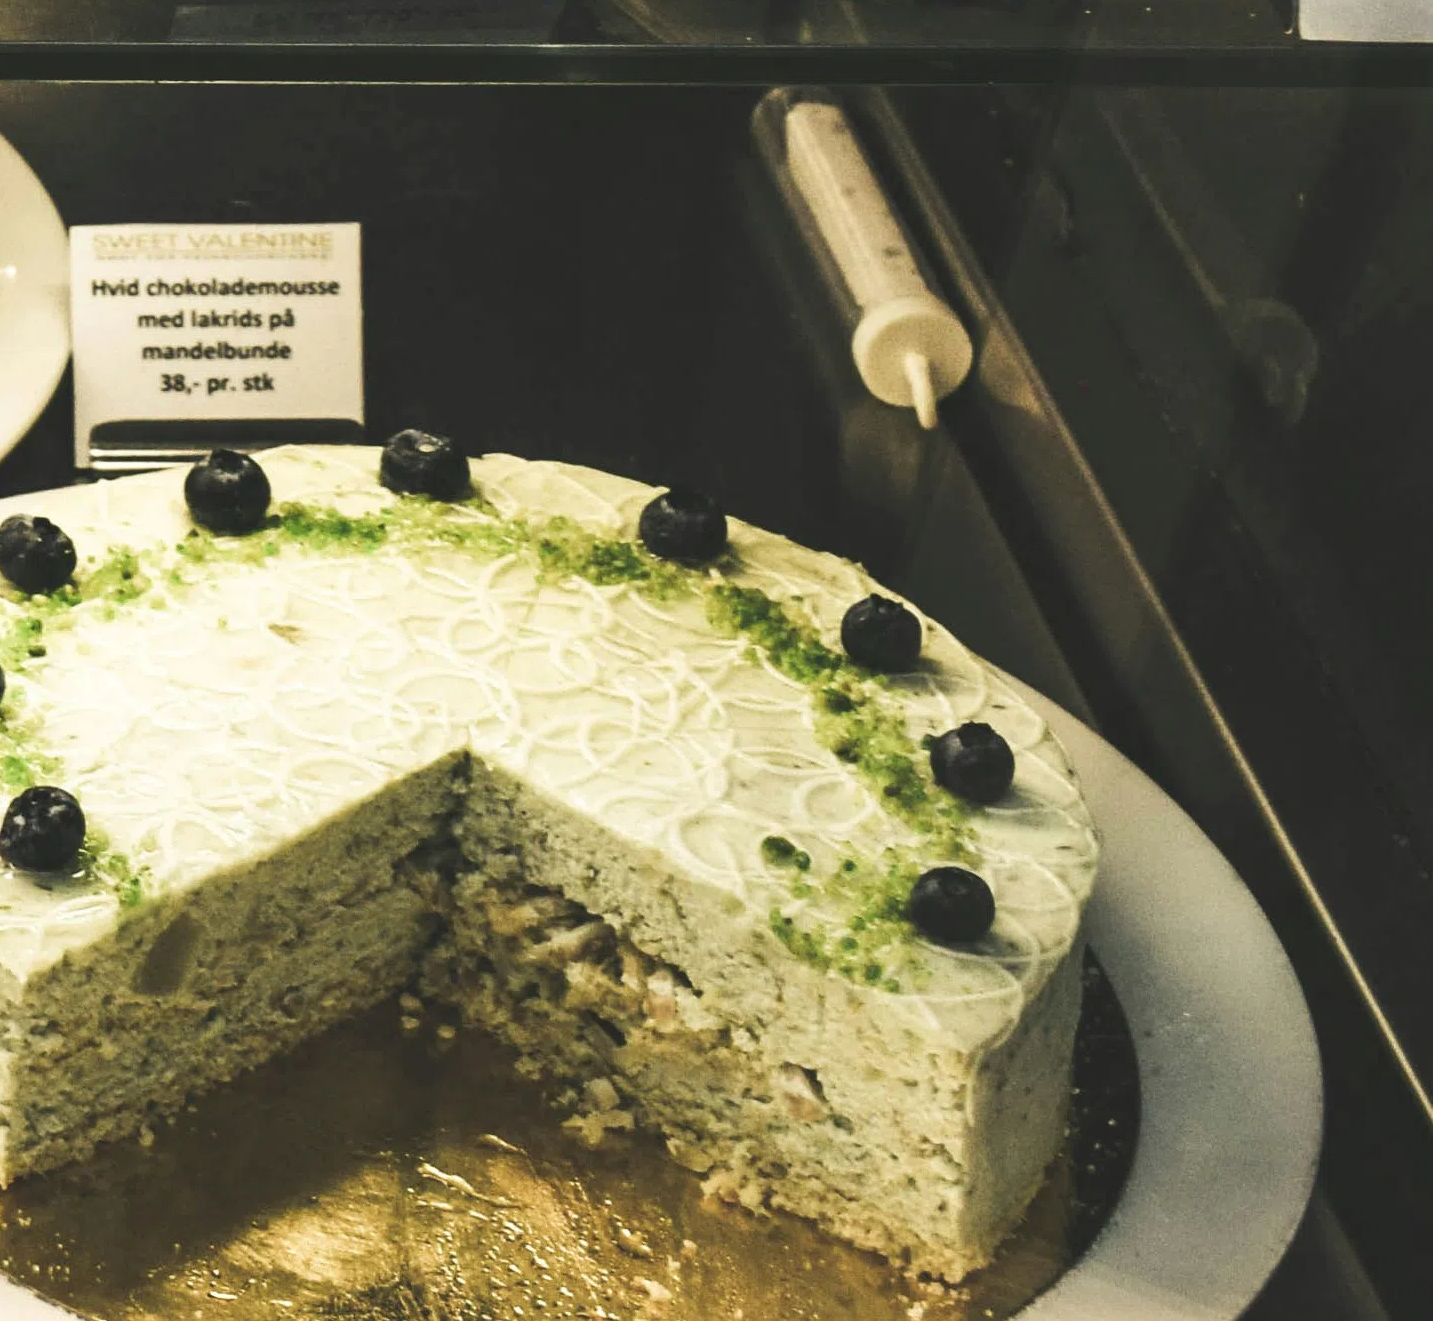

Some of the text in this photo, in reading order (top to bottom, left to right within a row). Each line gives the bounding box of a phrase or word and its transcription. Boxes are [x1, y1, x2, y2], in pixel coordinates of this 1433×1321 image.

[91, 278, 340, 296] Hvid chokolademousse
[138, 308, 295, 331] med lakrids på
[142, 341, 292, 359] mandelbunde
[160, 373, 274, 395] 38,- pr. stk
